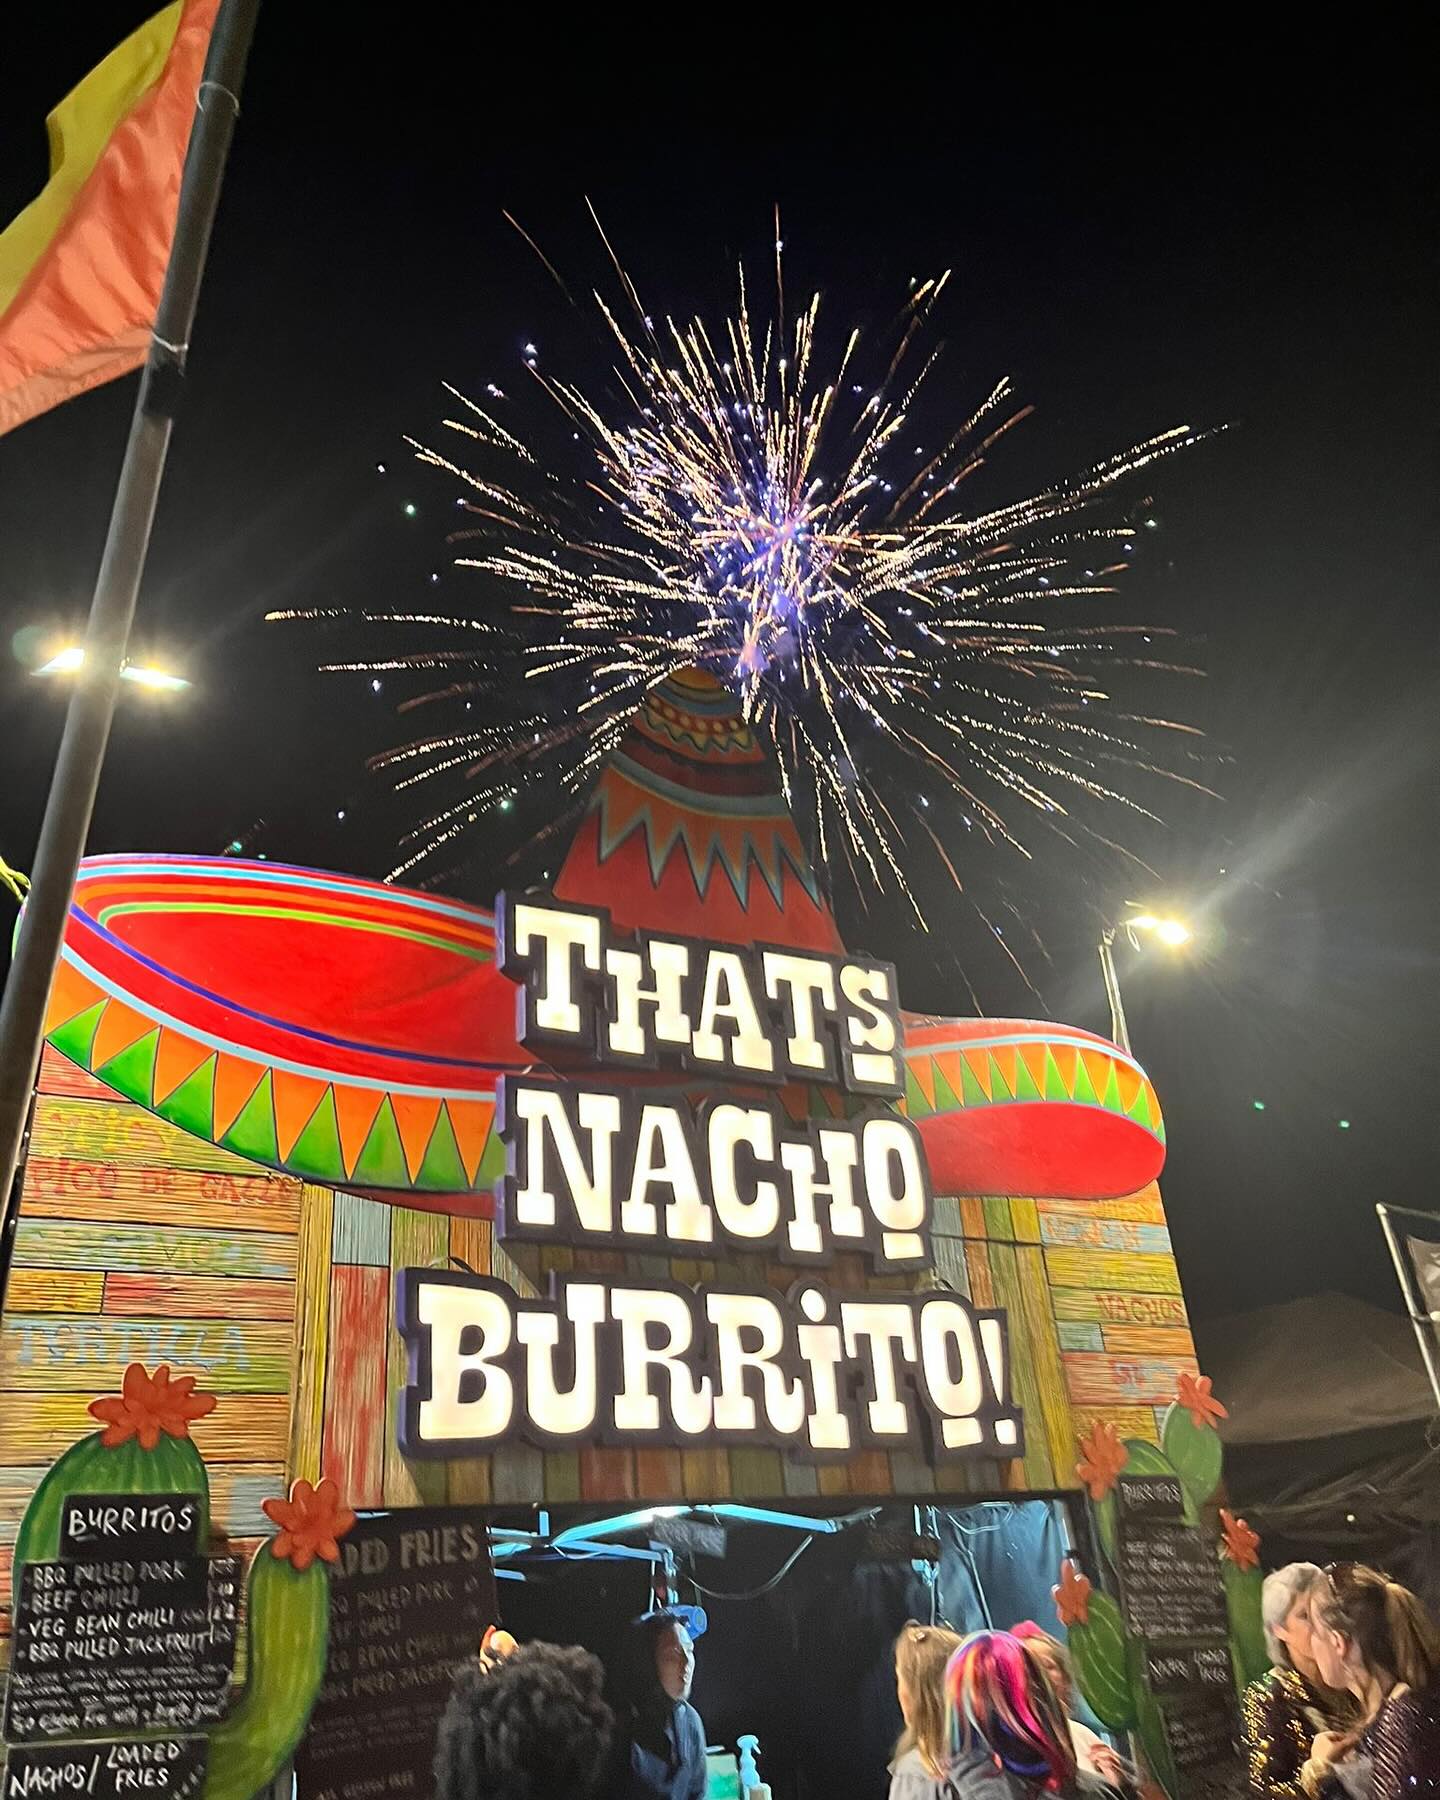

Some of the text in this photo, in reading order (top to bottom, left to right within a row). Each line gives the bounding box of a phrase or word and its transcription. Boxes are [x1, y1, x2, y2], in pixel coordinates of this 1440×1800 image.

[514, 903, 898, 1086] THATS
[26, 1158, 119, 1200] PICO
[515, 1087, 927, 1261] NACHO
[1096, 1294, 1186, 1324] NACHOS
[67, 1504, 194, 1541] BURRITOS
[401, 1524, 481, 1570] FRIES
[32, 1565, 67, 1590] BBQ
[31, 1591, 77, 1616] BEEF
[29, 1617, 67, 1640] VEG
[74, 1610, 121, 1637] BEAN
[126, 1606, 175, 1630] CHILLI
[29, 1641, 60, 1663] BBQ
[65, 1634, 121, 1662] PULLED
[123, 1630, 208, 1656] JACKFRUIT
[106, 1741, 181, 1769] LOADED
[115, 1766, 170, 1793] FRIES
